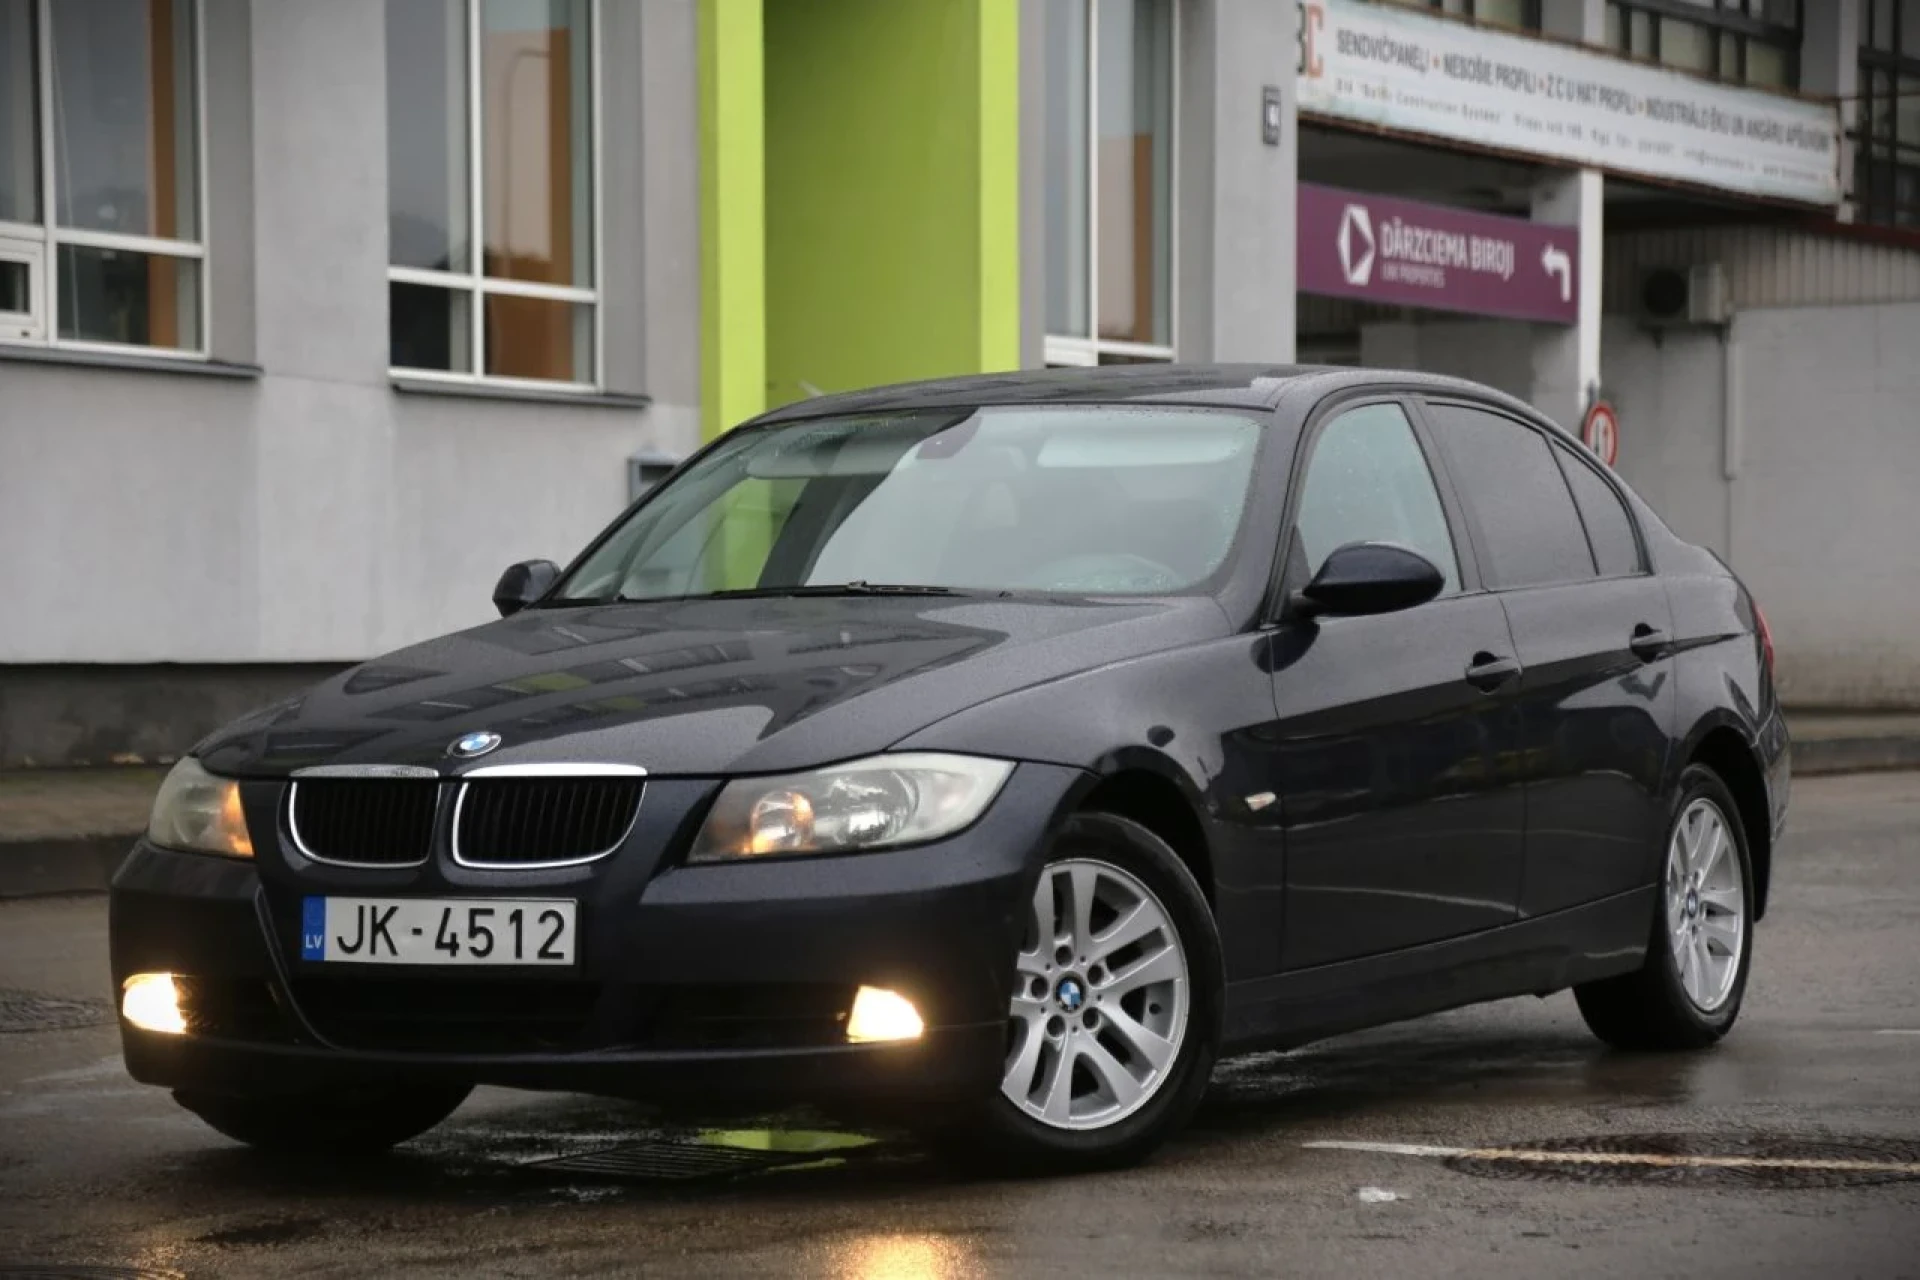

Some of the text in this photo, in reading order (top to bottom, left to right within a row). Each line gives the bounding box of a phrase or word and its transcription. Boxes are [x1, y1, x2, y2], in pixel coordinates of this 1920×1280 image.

[1380, 216, 1515, 281] DĀRZCIEMA BIROJI
[305, 904, 566, 960] LV JK-4512
